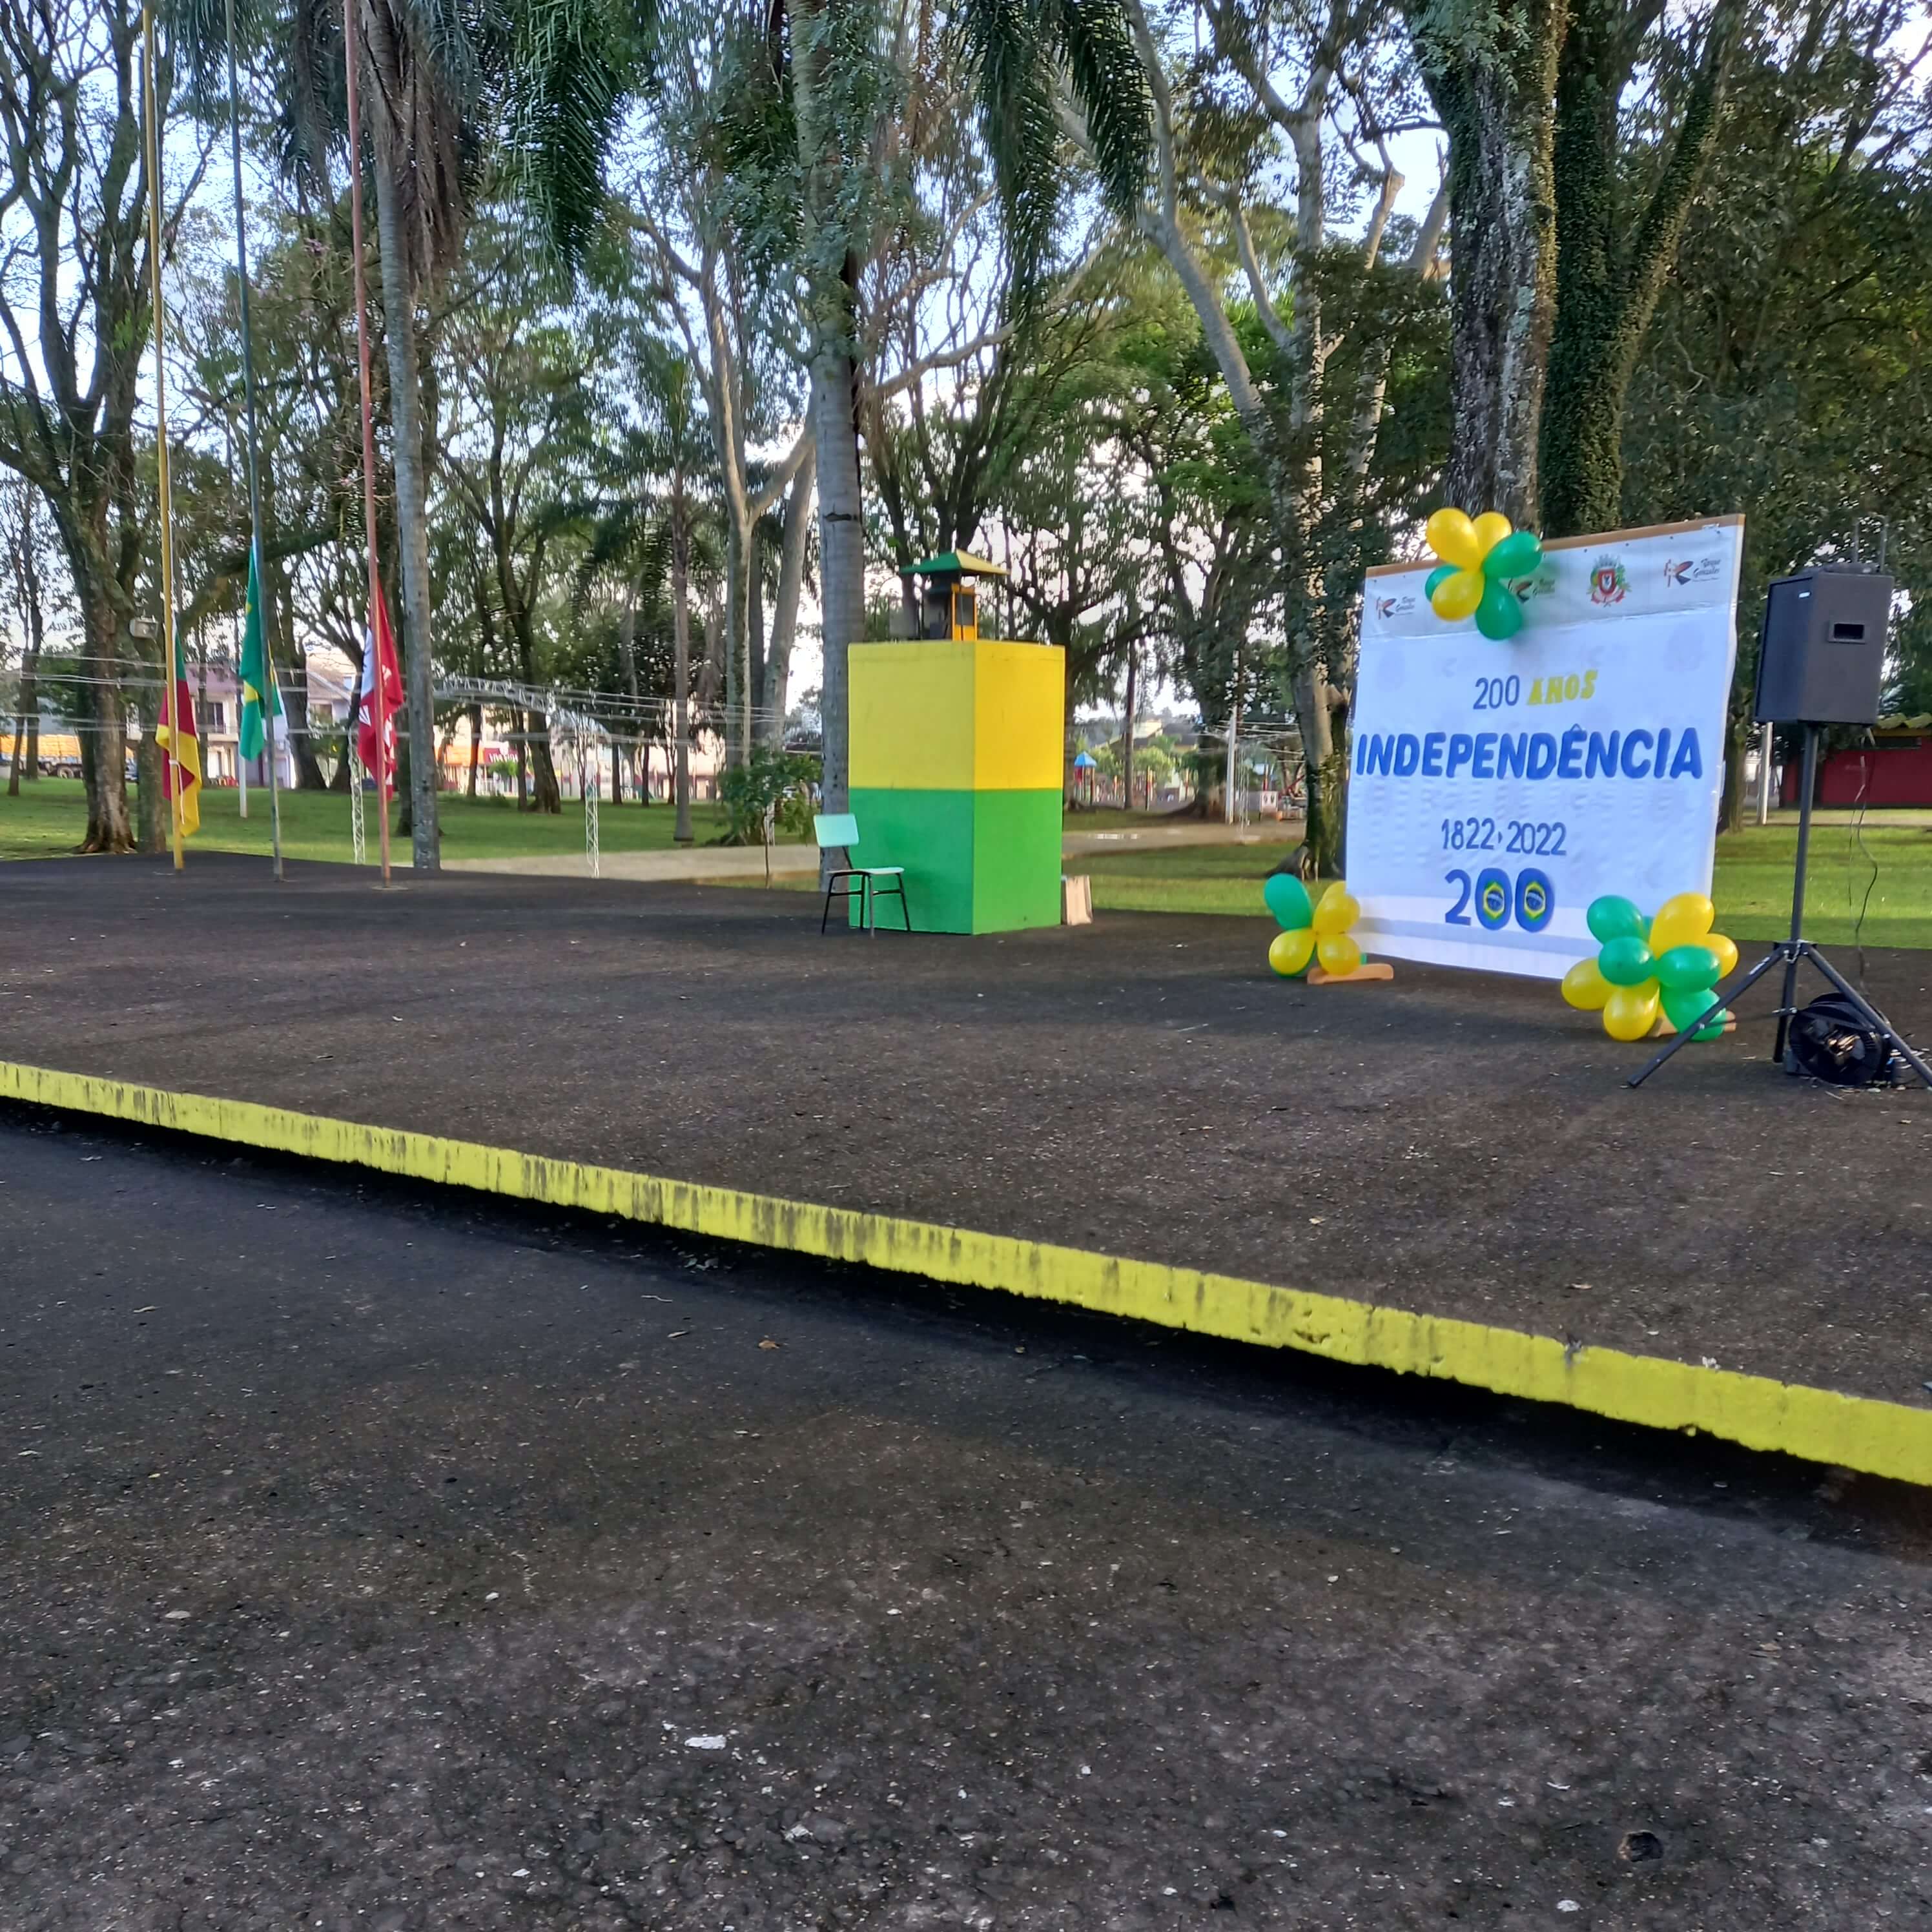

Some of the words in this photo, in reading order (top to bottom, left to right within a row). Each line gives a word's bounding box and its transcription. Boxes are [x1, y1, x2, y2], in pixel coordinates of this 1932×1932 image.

[1473, 675, 1520, 710] 200
[1526, 670, 1598, 705] ANOS
[1356, 723, 1703, 779] INDEPENDÊNCIA
[1444, 867, 1555, 933] 200
